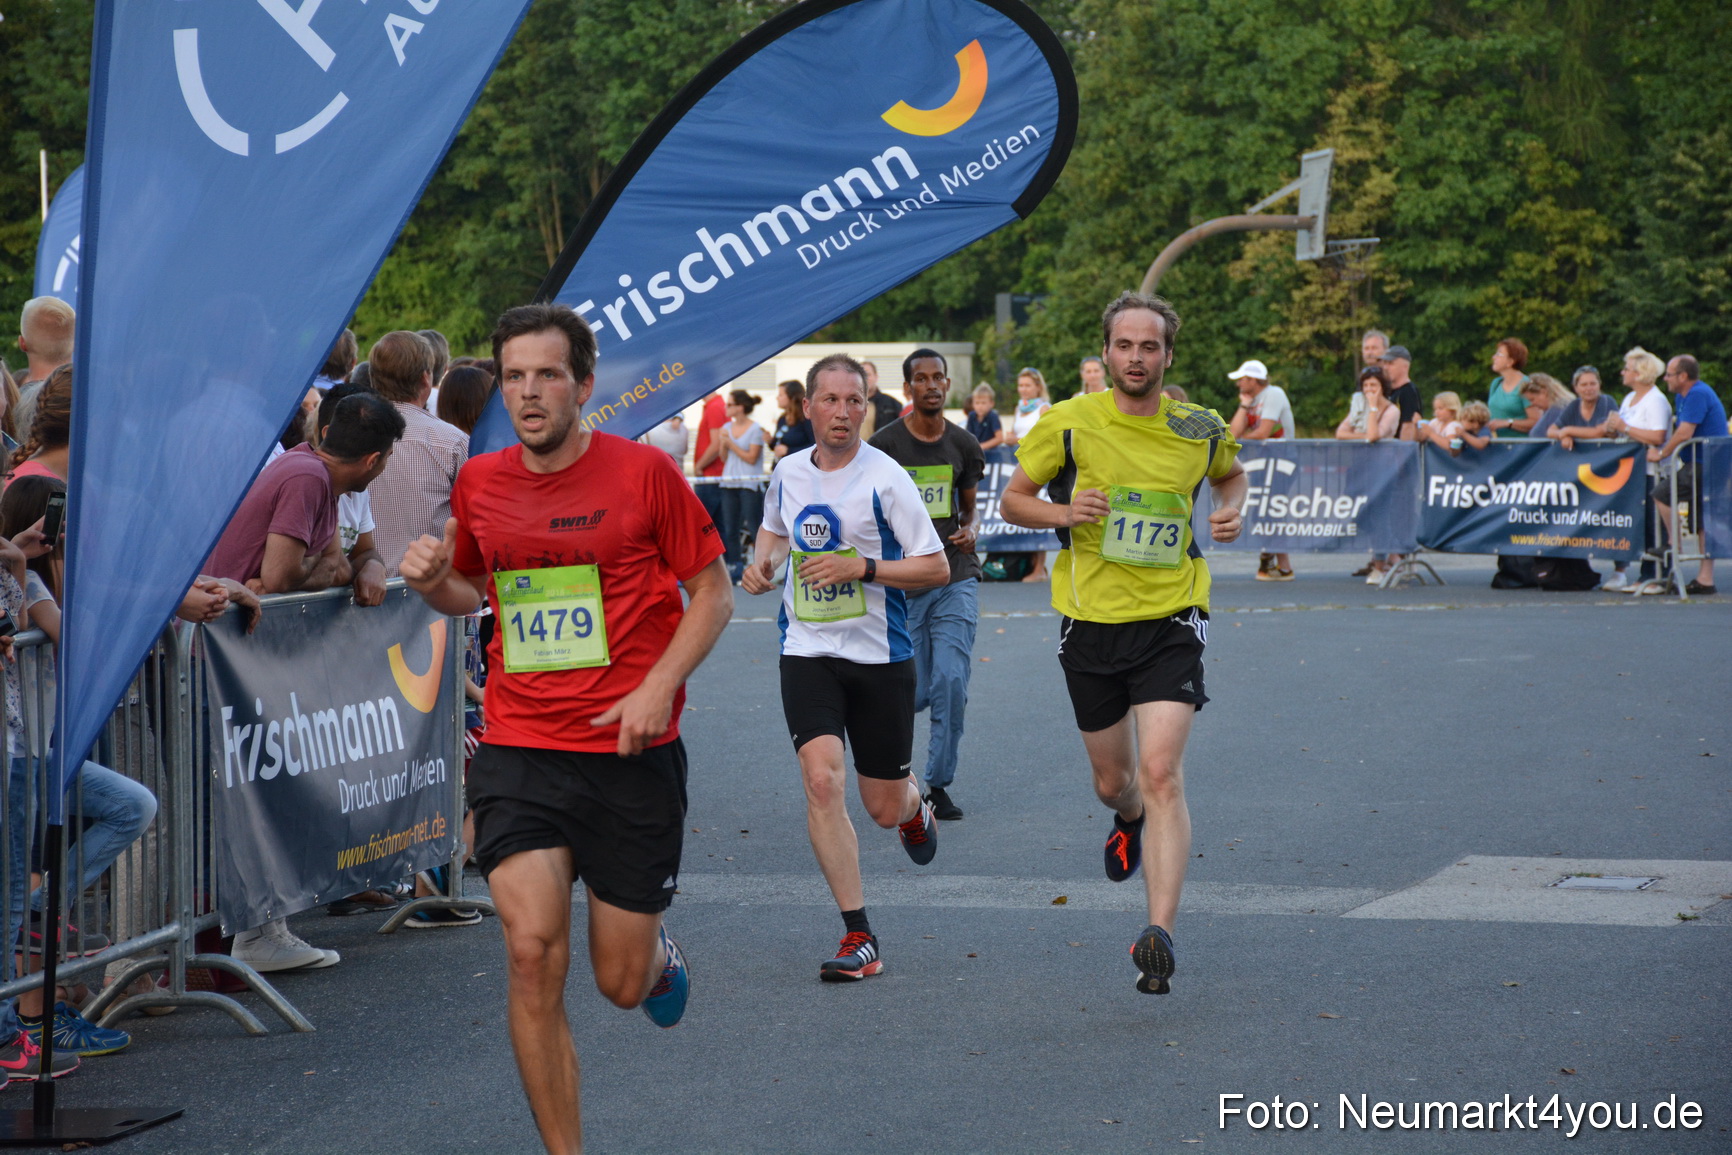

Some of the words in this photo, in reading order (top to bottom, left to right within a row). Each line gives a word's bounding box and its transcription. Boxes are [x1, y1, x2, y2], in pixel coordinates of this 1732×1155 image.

[796, 212, 881, 270] Druck
[884, 185, 941, 221] und
[939, 123, 1041, 196] Medien
[1241, 487, 1368, 519] Fischer
[1428, 475, 1579, 508] Frischmann
[549, 516, 588, 529] swn
[803, 523, 827, 536] TÜV
[1113, 517, 1179, 547] 1173
[1251, 522, 1357, 537] AUTOMOBILE
[1508, 507, 1549, 524] Druck
[1552, 509, 1578, 526] und
[1580, 510, 1633, 528] Medien
[809, 539, 822, 547] SÜD
[1510, 532, 1631, 551] www.frischmann-net.de
[800, 579, 856, 602] 1594
[511, 606, 593, 642] 1479
[221, 691, 404, 789] Frischmann
[338, 769, 379, 814] Druck
[382, 761, 407, 802] und
[337, 811, 446, 870] www.frischmann-net.de
